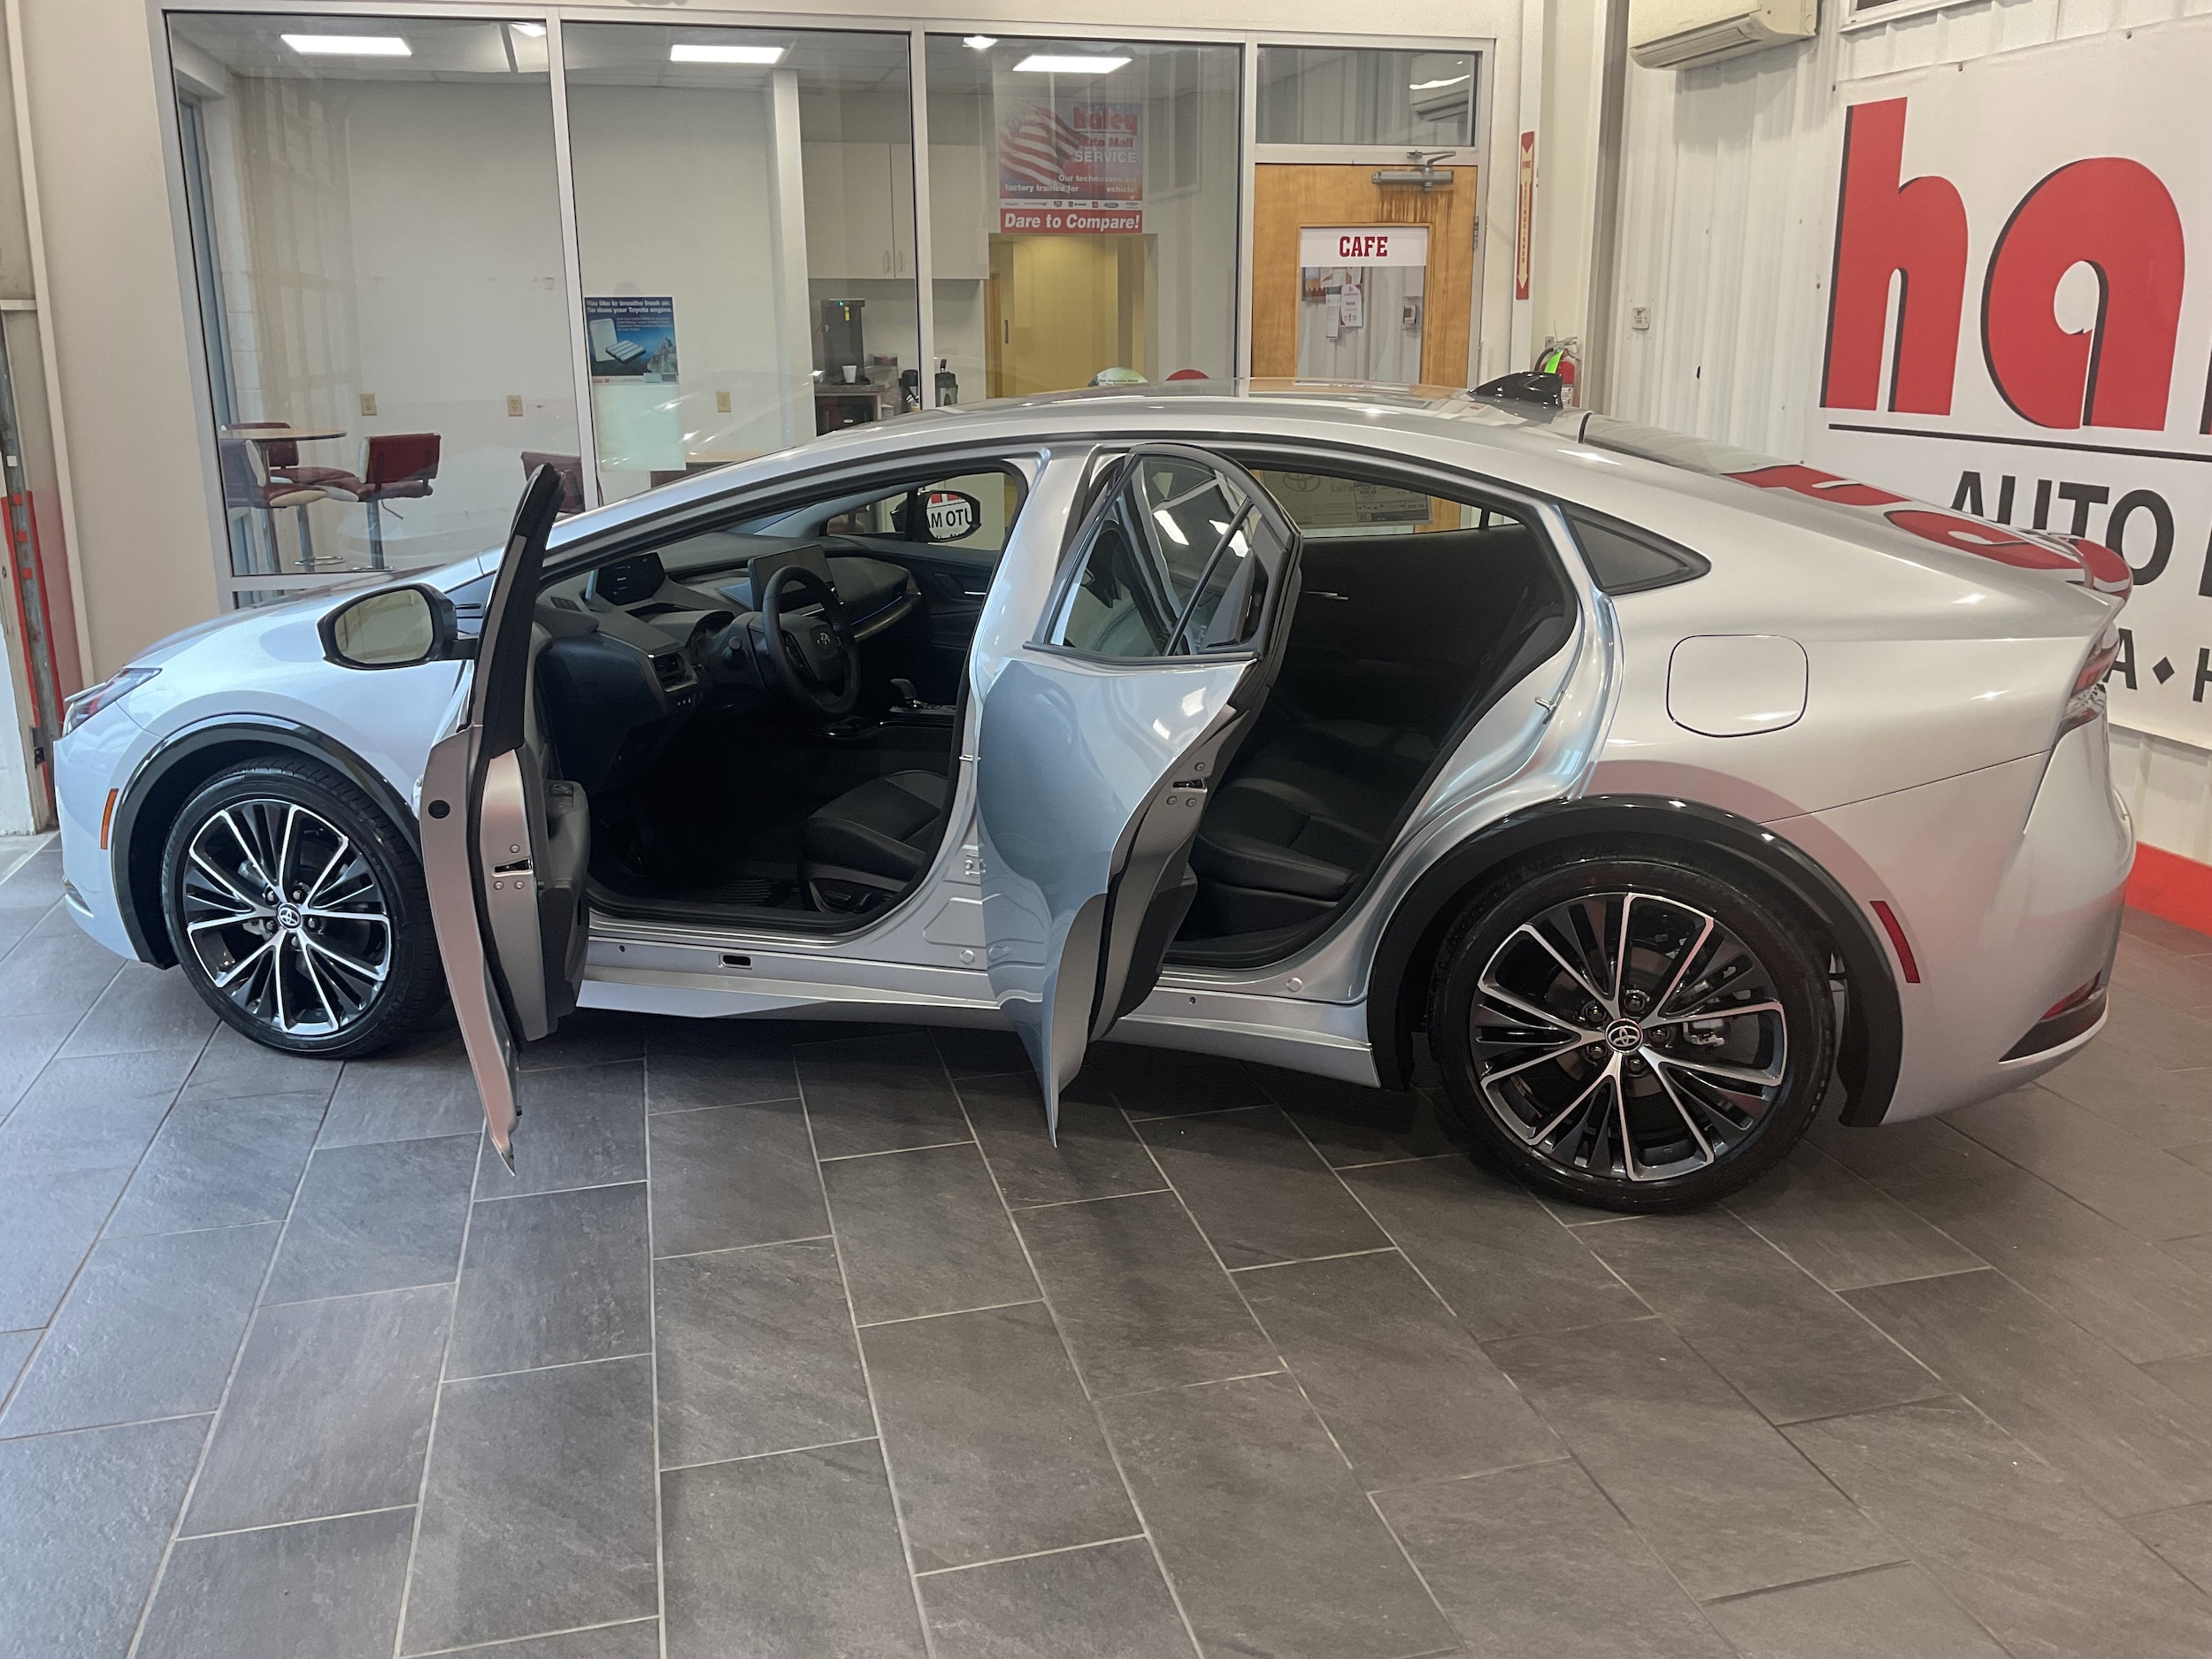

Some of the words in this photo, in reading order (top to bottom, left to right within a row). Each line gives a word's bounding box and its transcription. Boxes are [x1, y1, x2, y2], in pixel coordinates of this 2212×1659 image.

[1074, 151, 1137, 164] SERVICE
[1005, 184, 1034, 193] factory
[1067, 185, 1079, 194] for
[1004, 212, 1041, 228] Dare
[1046, 214, 1062, 228] to
[1066, 213, 1141, 232] Compare!
[1339, 235, 1388, 257] CAFE
